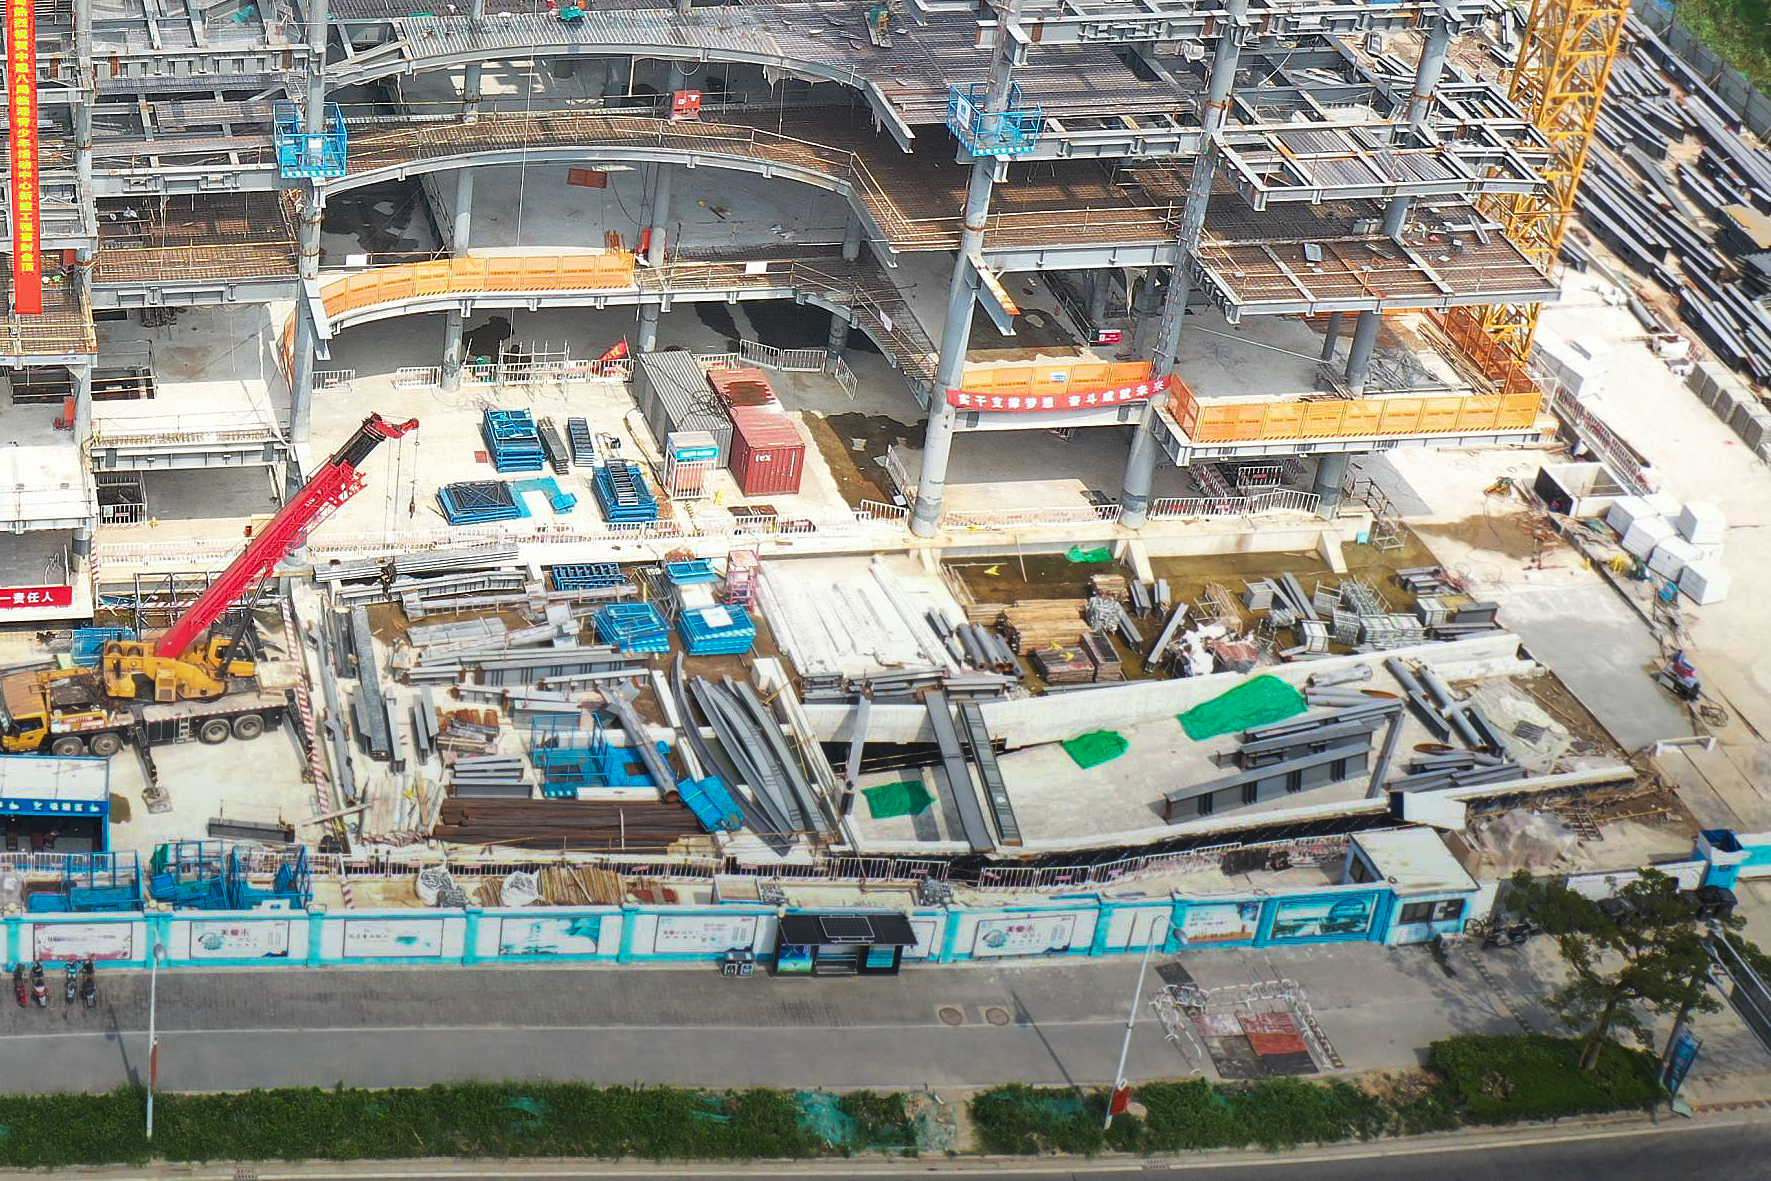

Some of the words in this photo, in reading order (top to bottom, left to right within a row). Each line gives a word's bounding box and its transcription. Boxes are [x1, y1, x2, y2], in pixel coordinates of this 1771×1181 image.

[957, 393, 1055, 409] 实干支撑梦想
[1068, 381, 1165, 406] 奋斗成就未来
